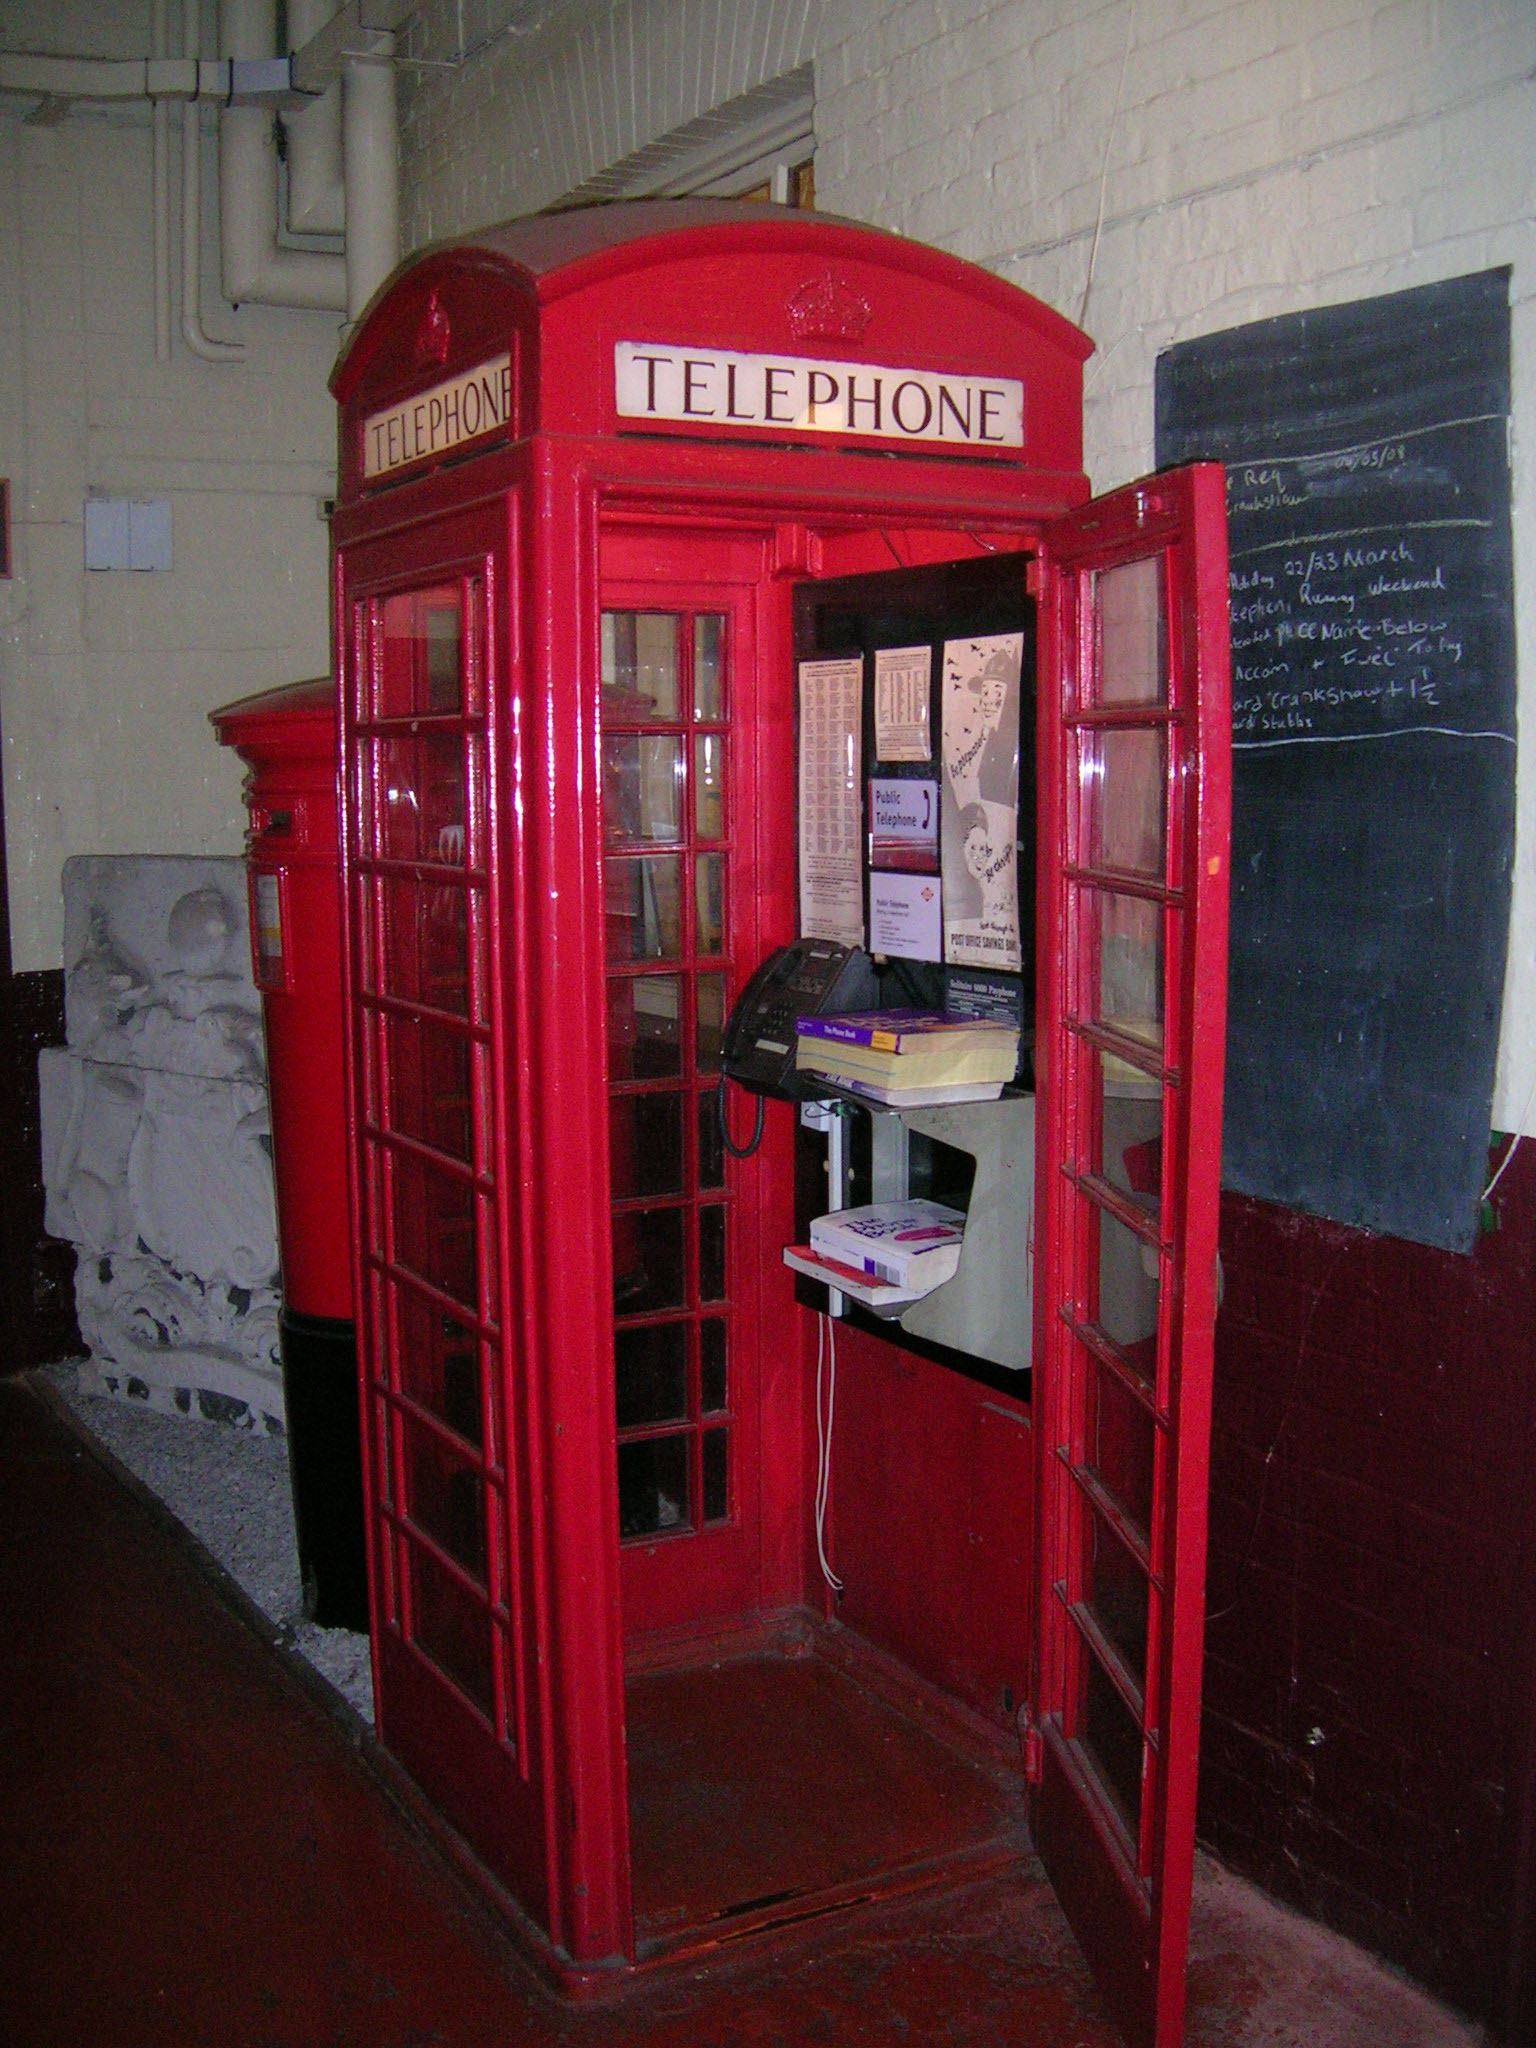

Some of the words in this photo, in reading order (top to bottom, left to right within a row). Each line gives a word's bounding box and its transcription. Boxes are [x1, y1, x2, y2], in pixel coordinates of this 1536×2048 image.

[632, 356, 1006, 442] TELEPHONE
[371, 366, 511, 472] TELEPHONE
[1343, 540, 1416, 568] March
[1231, 695, 1263, 713] ard
[1231, 715, 1257, 730] ard
[876, 790, 901, 805] Public
[876, 811, 917, 829] Telephone
[951, 933, 964, 946] POST
